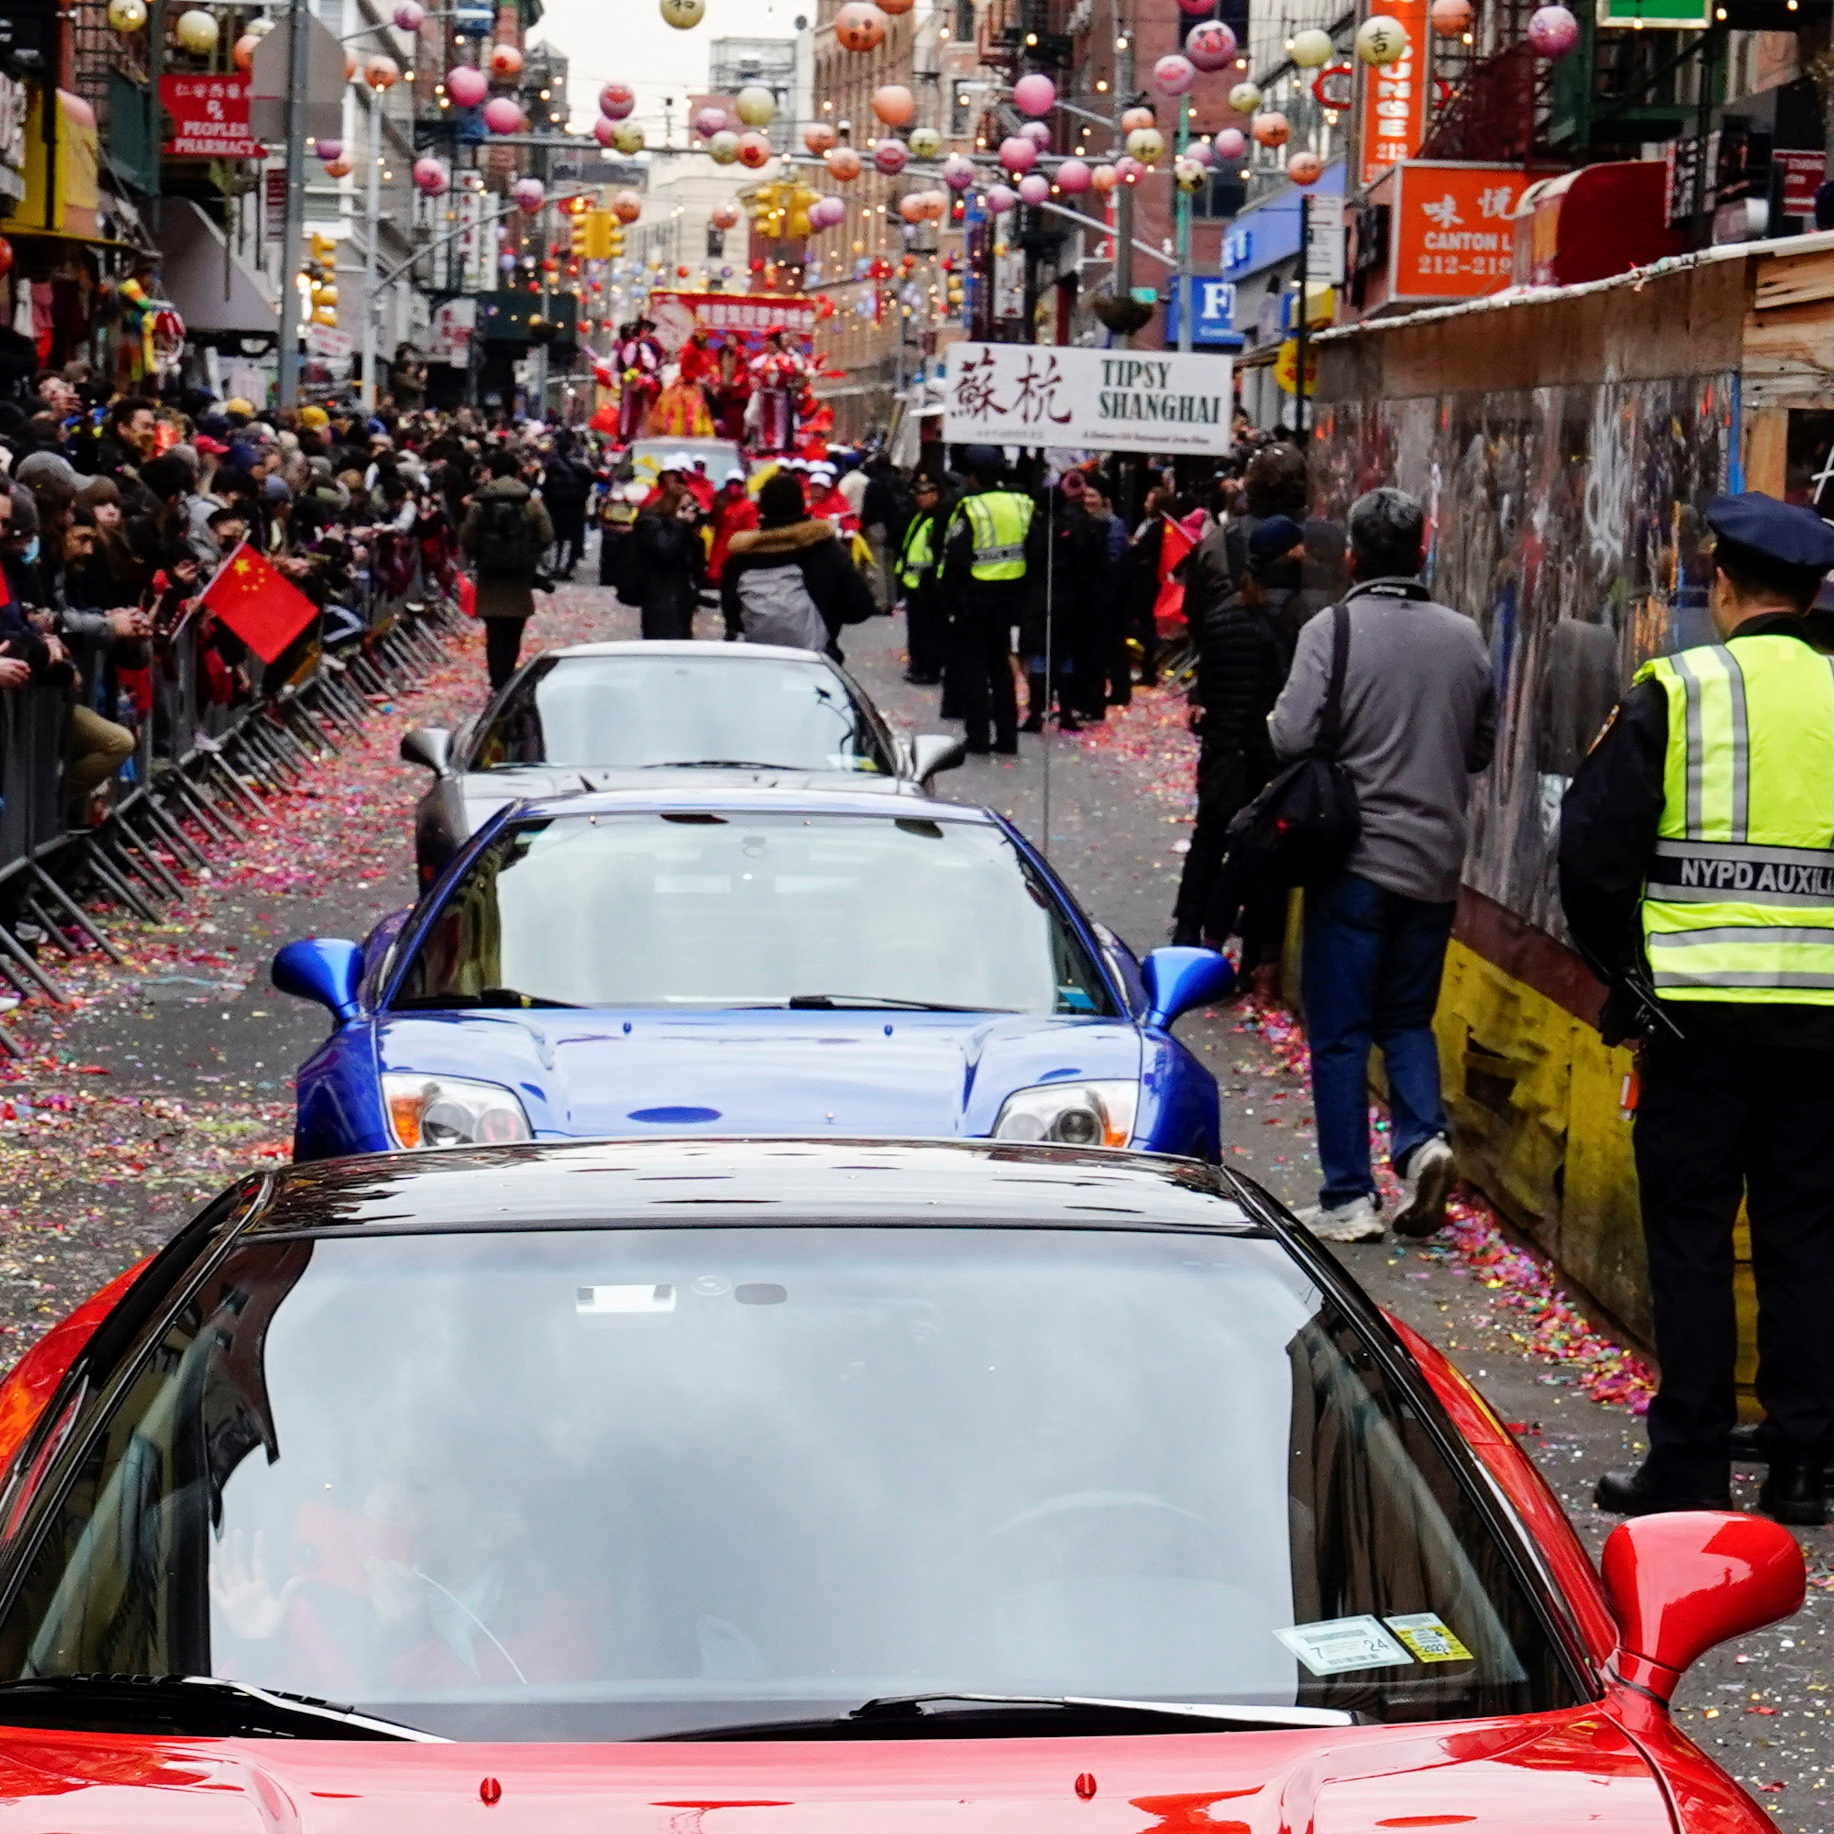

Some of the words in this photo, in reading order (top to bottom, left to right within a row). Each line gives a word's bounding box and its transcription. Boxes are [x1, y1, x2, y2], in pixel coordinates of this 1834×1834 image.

[1423, 232, 1498, 250] CANTON
[1101, 359, 1172, 389] TIPSY
[1098, 391, 1221, 425] SHANGHAI
[1680, 859, 1754, 889] NYPD
